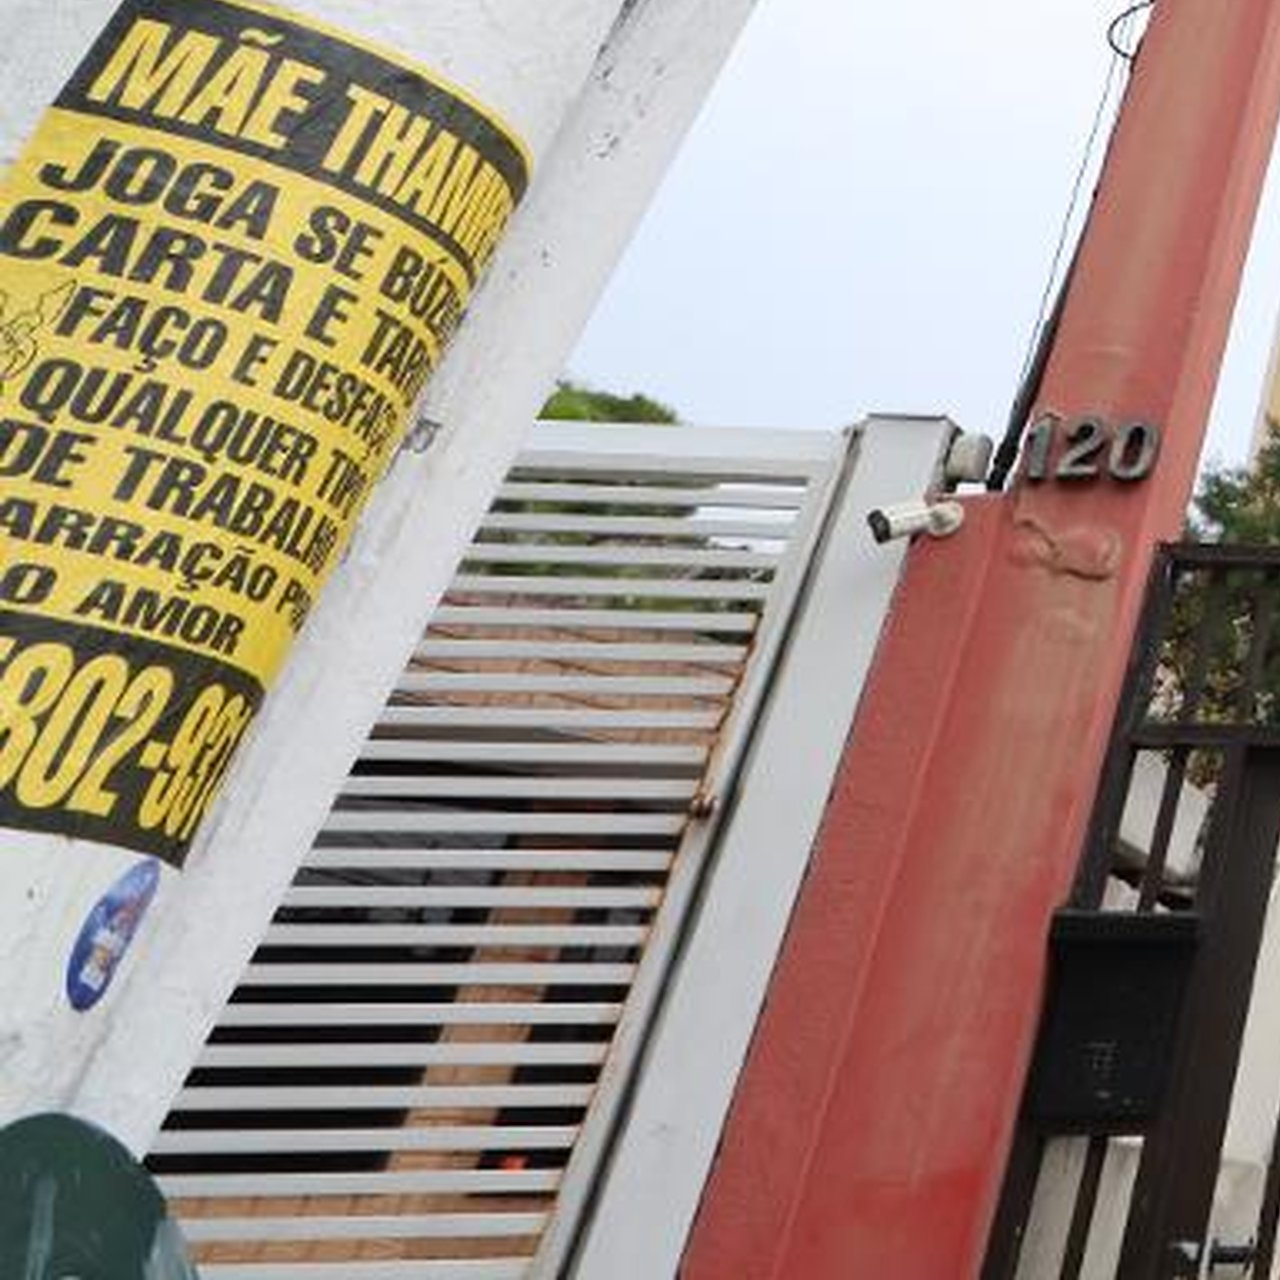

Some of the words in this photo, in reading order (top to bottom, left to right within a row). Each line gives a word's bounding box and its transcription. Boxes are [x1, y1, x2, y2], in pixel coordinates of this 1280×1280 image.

[86, 15, 325, 152] MÃE
[38, 135, 280, 240] JOGA
[294, 206, 384, 280] SE
[0, 198, 294, 324] CARTA
[303, 282, 358, 348] E
[54, 286, 228, 373] FAÇO
[232, 333, 278, 386] E
[0, 420, 95, 488] DE
[18, 358, 318, 488] QUALQUER
[1029, 414, 1161, 480] 120
[74, 580, 244, 656] AMOR
